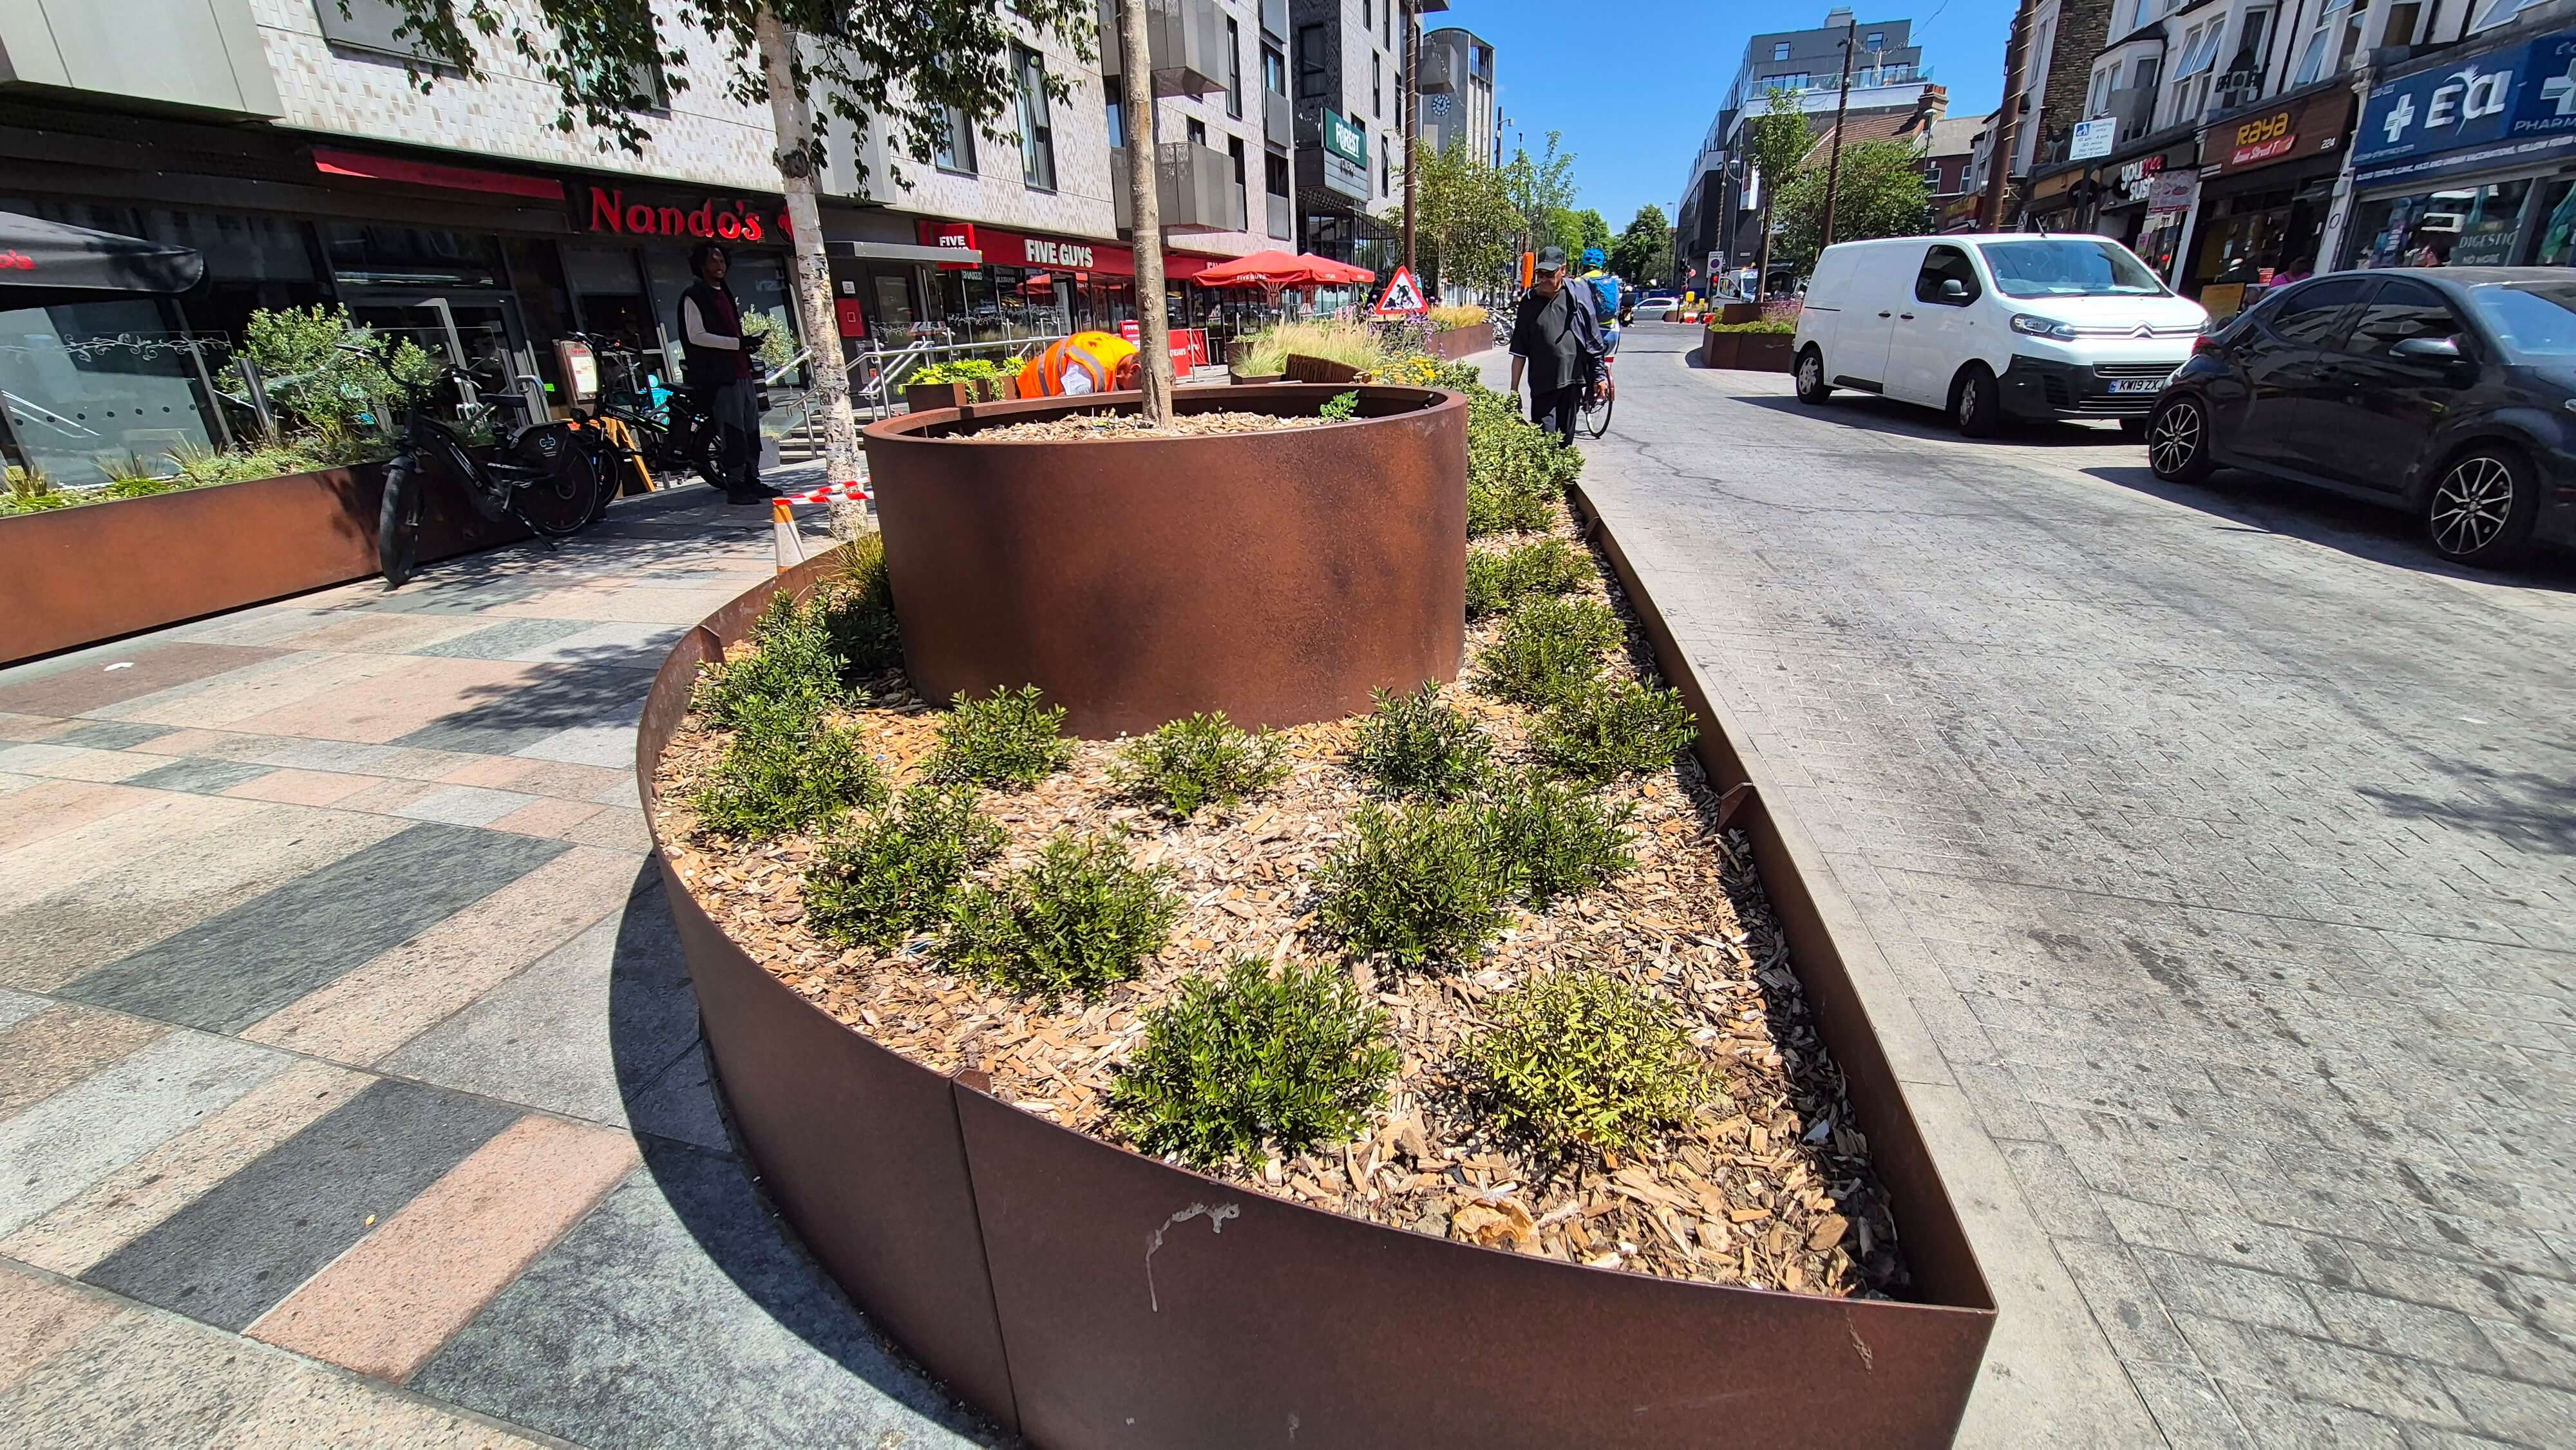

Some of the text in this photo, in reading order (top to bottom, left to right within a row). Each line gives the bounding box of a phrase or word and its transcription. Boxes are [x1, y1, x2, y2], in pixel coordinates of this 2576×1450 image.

[1335, 122, 1359, 155] FOREST
[589, 186, 762, 241] Nando's
[939, 236, 965, 247] FIVE
[1024, 239, 1094, 268] FIVE GUYS
[2119, 381, 2144, 390] KW19
